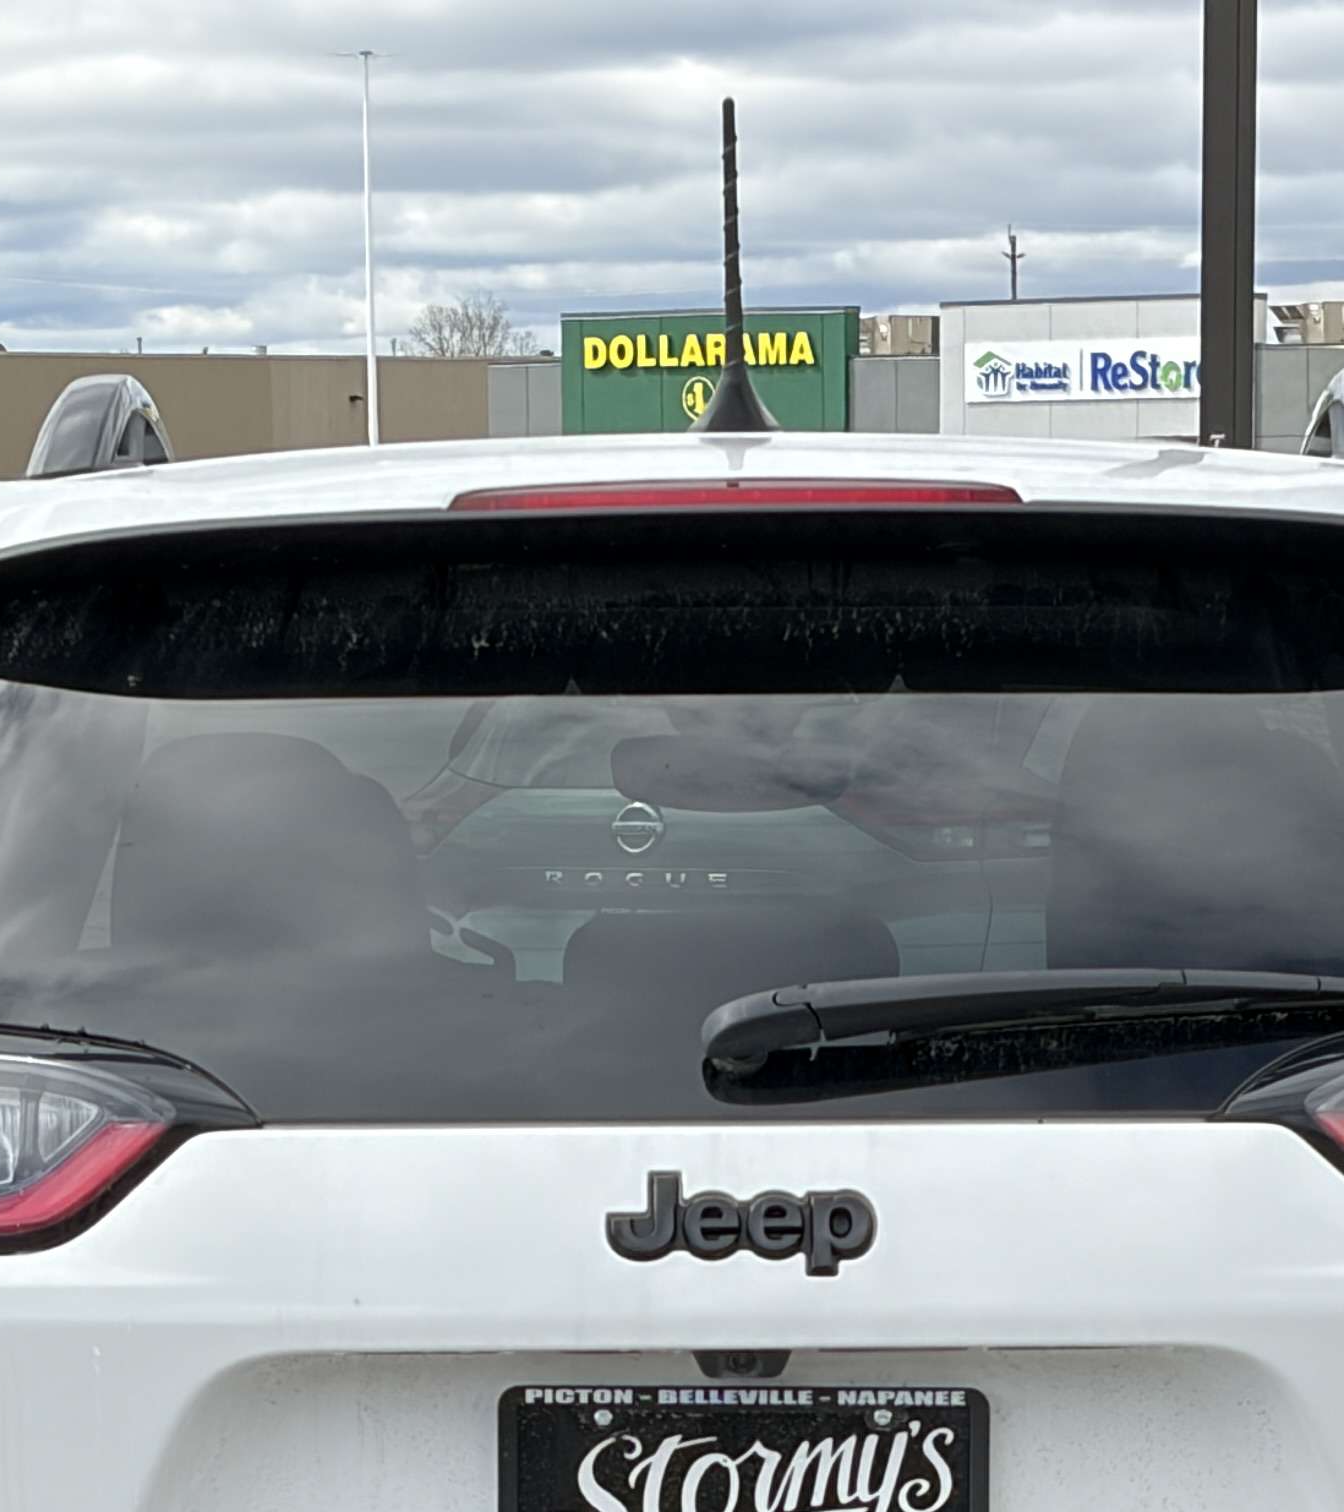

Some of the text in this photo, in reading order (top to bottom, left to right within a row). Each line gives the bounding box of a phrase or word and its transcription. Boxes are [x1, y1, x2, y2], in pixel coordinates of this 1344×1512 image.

[1015, 350, 1201, 391] Habitat ReStor
[545, 870, 728, 888] ROGUE
[605, 1170, 877, 1276] Jeep
[525, 1388, 633, 1405] PICTON
[658, 1389, 813, 1405] BELLEVILLE
[838, 1390, 966, 1406] NAPANEE
